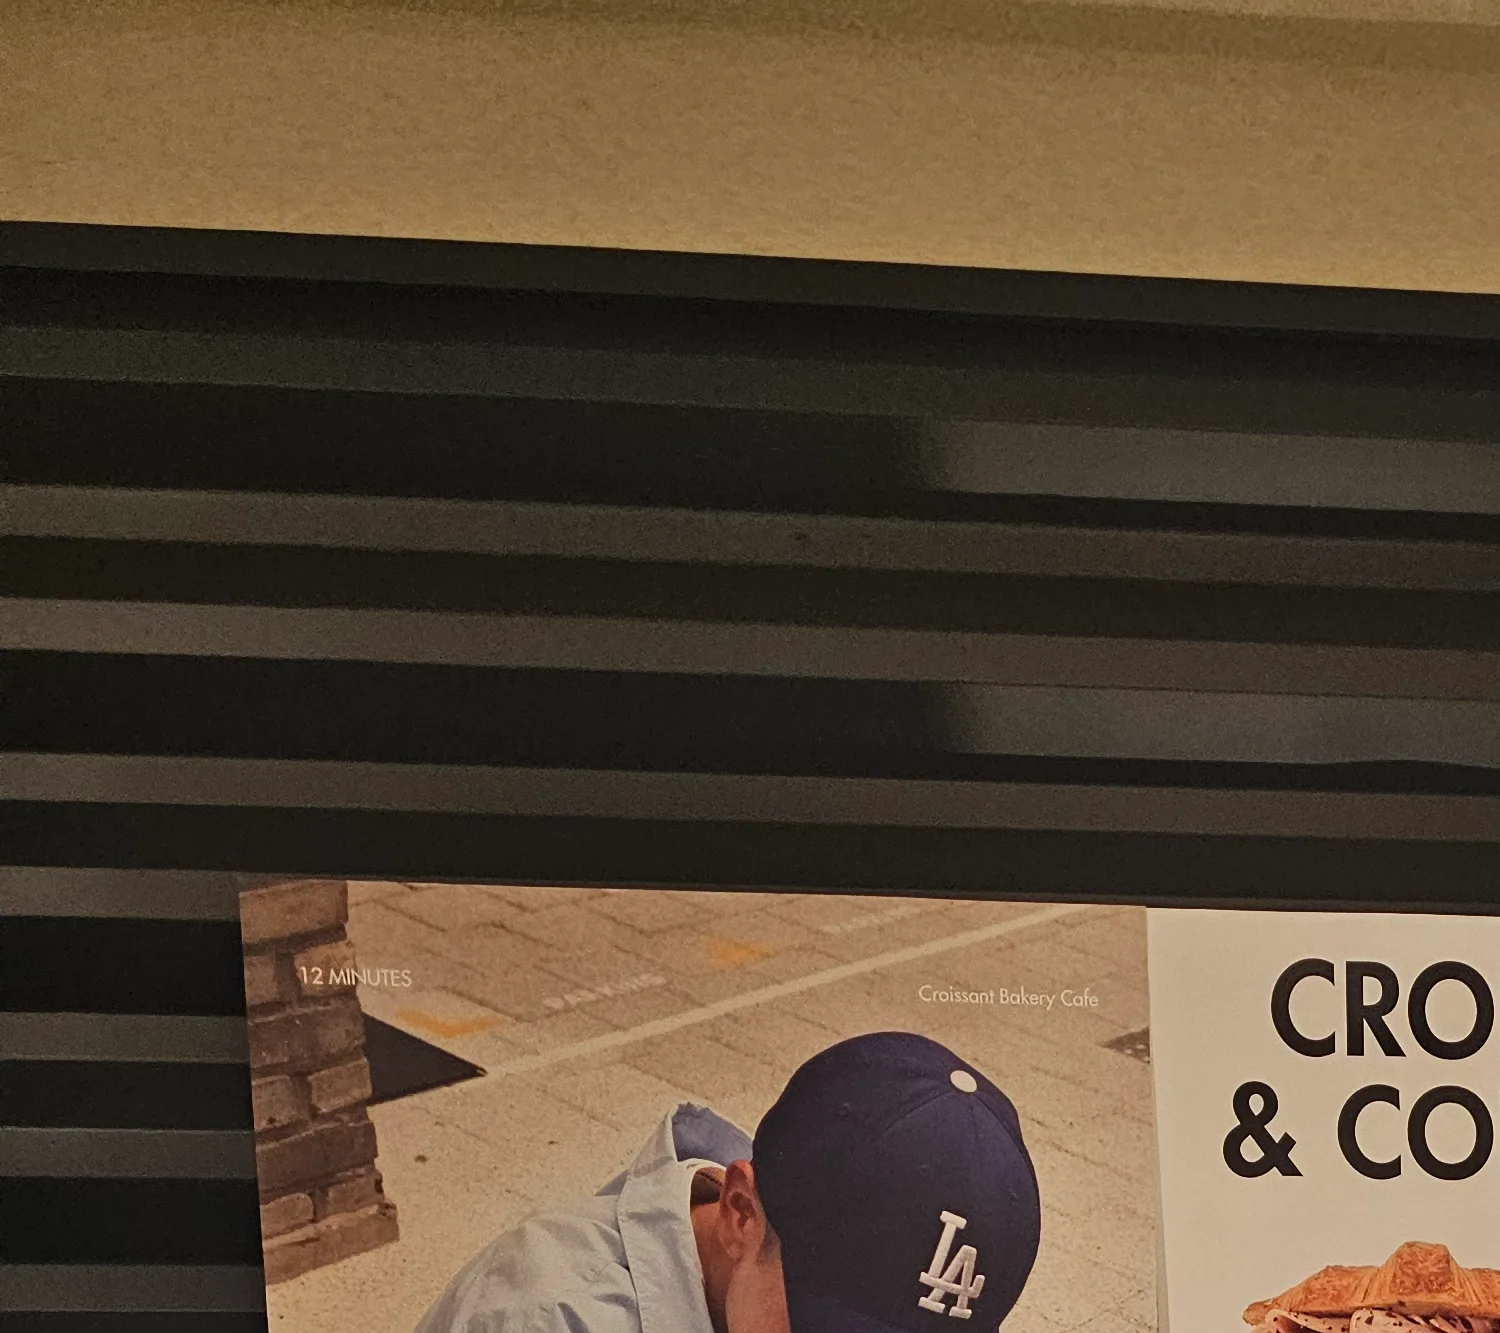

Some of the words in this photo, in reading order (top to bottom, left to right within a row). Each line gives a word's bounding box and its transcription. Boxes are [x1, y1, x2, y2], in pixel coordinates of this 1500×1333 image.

[300, 966, 324, 985] 12
[328, 967, 412, 987] MINUTES
[918, 984, 994, 1004] Croissant
[999, 985, 1056, 1010] Bakery
[1061, 987, 1099, 1007] Cafe
[1222, 1081, 1304, 1178] &
[918, 1210, 985, 1320] LA
